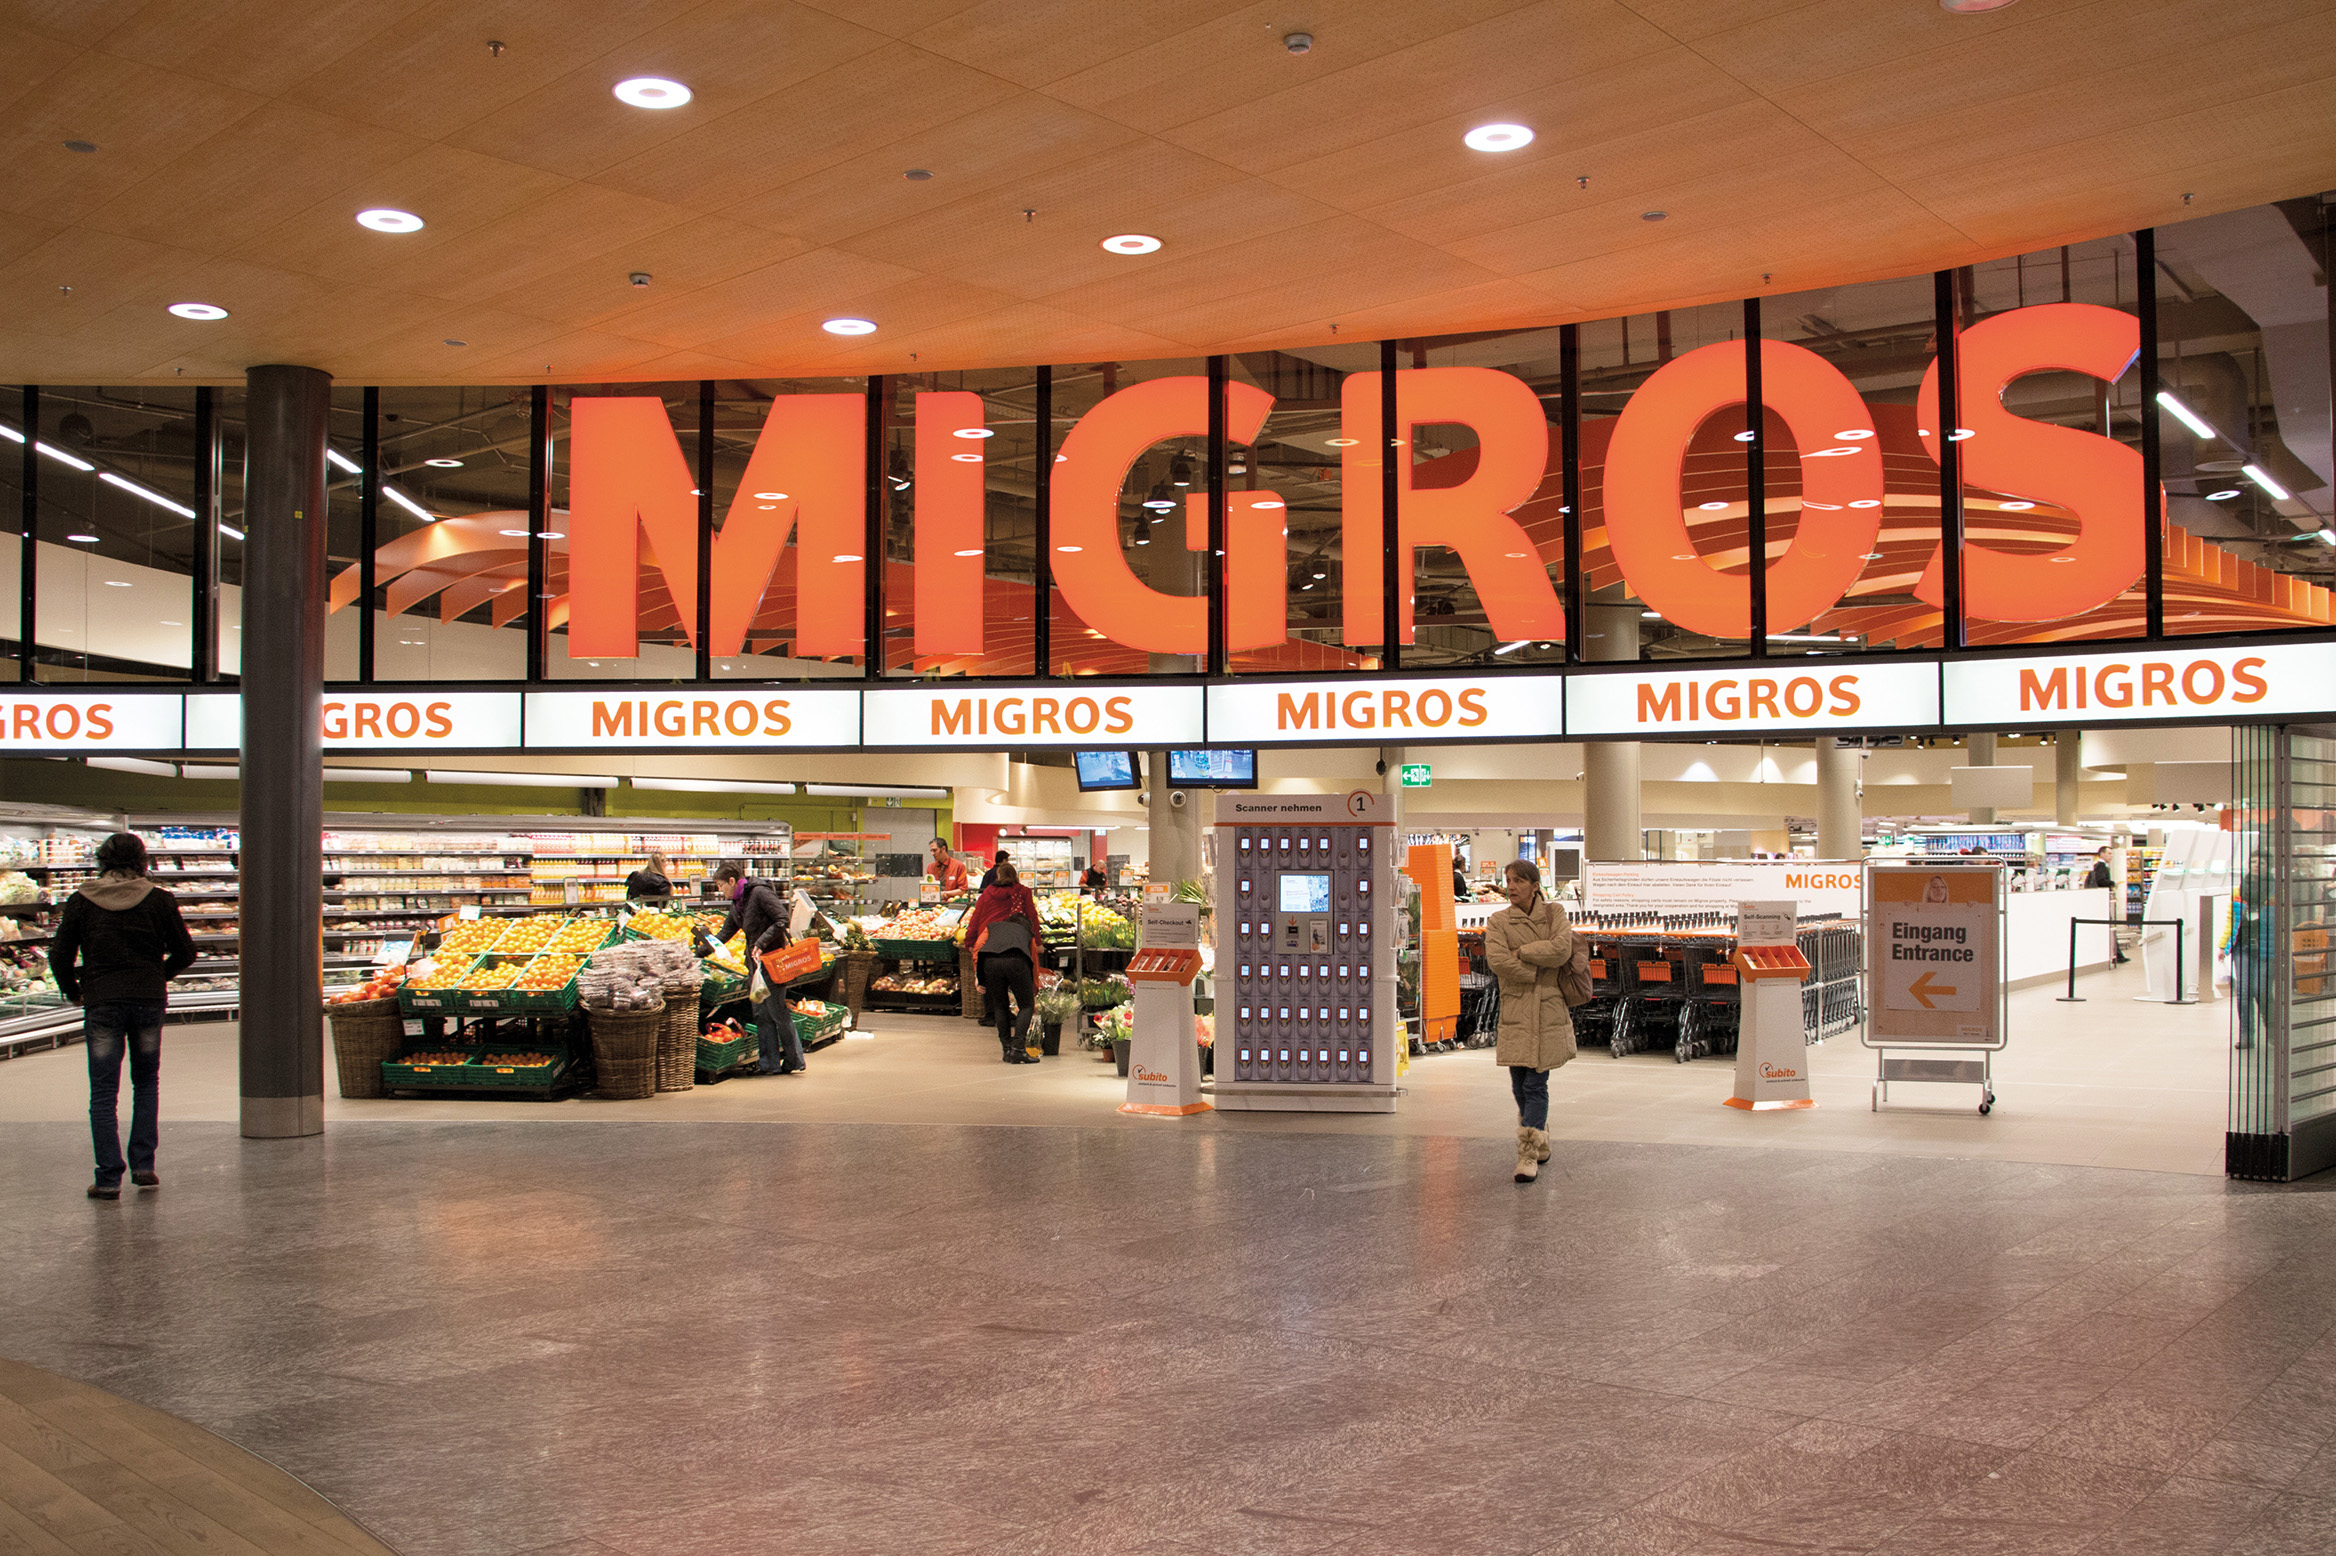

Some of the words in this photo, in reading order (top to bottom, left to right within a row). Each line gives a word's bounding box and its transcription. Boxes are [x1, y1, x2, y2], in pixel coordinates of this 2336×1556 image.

[568, 303, 2167, 659] MIGROS
[2020, 657, 2268, 711] MIGROS
[1278, 688, 1488, 729] MIGROS
[1637, 675, 1860, 722] MIGROS
[0, 704, 113, 740] ROS
[593, 700, 791, 737] MIGROS
[932, 697, 1133, 735] MIGROS
[1235, 803, 1278, 812] Scanner
[1280, 803, 1322, 812] nehmen
[1356, 796, 1366, 812] 1
[1785, 874, 1865, 889] MIGROS
[1743, 913, 1781, 921] Self-Scanning
[1892, 922, 1967, 944] Eingang
[785, 954, 812, 970] MIGROS
[1892, 943, 1974, 962] Entrance
[1138, 1071, 1168, 1082] subito
[1765, 1068, 1796, 1078] subito
